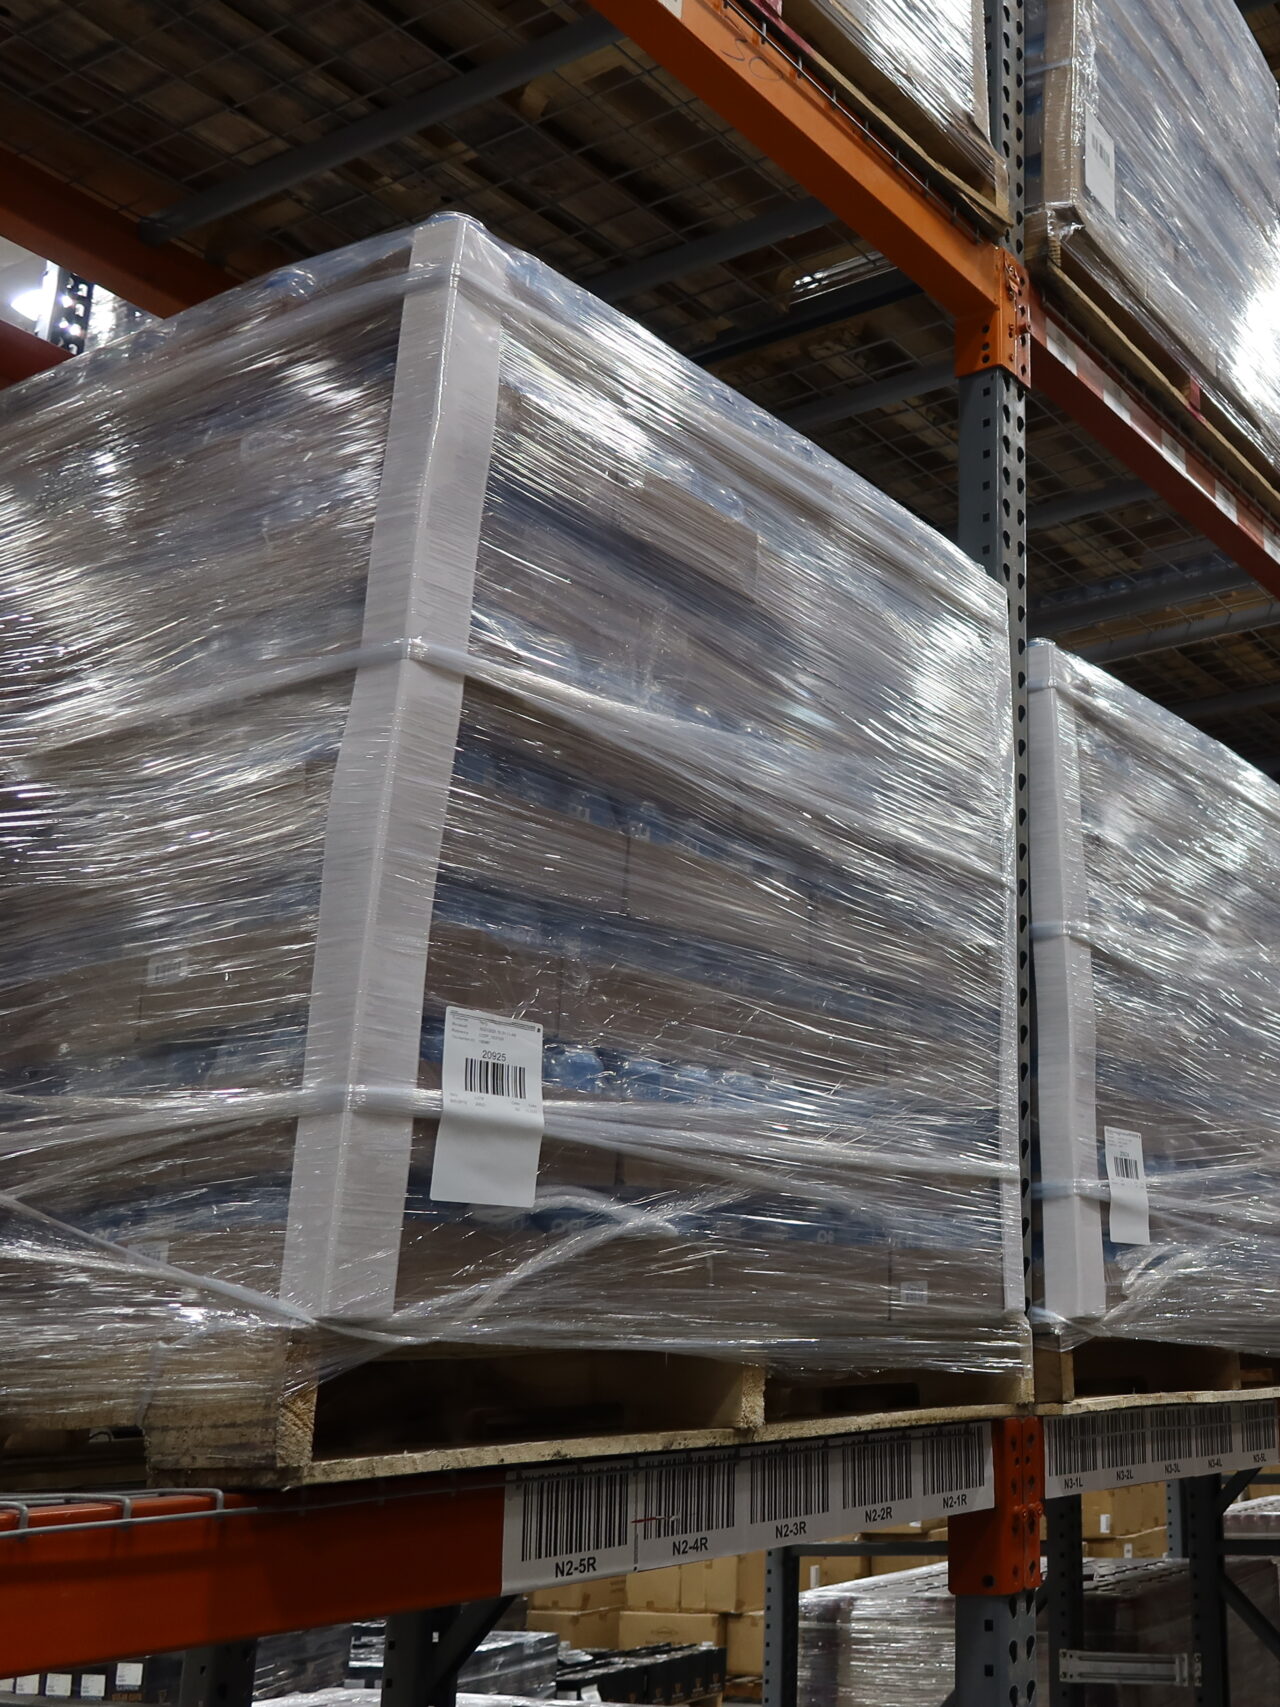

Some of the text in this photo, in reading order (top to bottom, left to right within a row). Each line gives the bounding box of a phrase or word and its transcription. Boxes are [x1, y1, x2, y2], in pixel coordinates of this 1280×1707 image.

[482, 1049, 506, 1062] 20925
[1208, 1458, 1223, 1469] N3-4L
[1253, 1454, 1267, 1464] N3-5L
[1116, 1469, 1134, 1481] N3-2L
[1164, 1463, 1181, 1474] N3-3L
[1064, 1476, 1084, 1490] N3-1L
[942, 1494, 967, 1509] N2-1R
[865, 1506, 893, 1523] N2-2R
[775, 1521, 807, 1539] N2-3R
[672, 1537, 709, 1556] N2-4R
[554, 1556, 597, 1578] N2-5R
